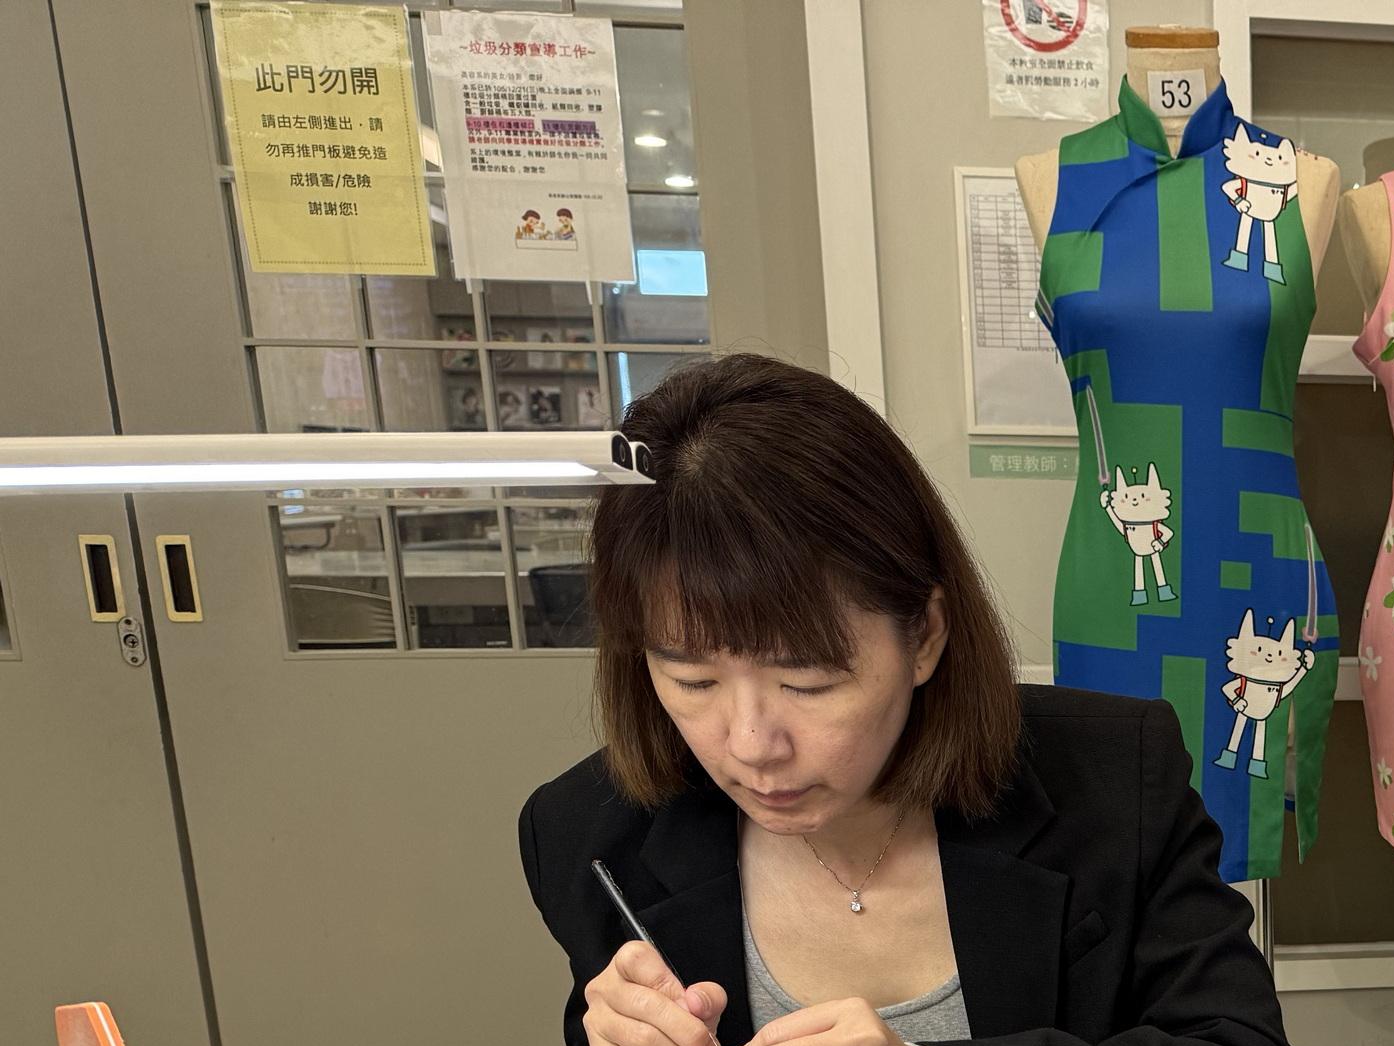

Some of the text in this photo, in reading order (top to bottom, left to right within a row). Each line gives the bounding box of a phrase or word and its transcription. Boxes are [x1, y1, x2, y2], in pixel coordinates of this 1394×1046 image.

[255, 63, 380, 96] 此門勿開
[1161, 79, 1192, 109] 53
[265, 143, 388, 160] 勿再推門板避免造
[290, 172, 372, 189] 成損害/危險
[308, 201, 358, 216] 謝謝您!
